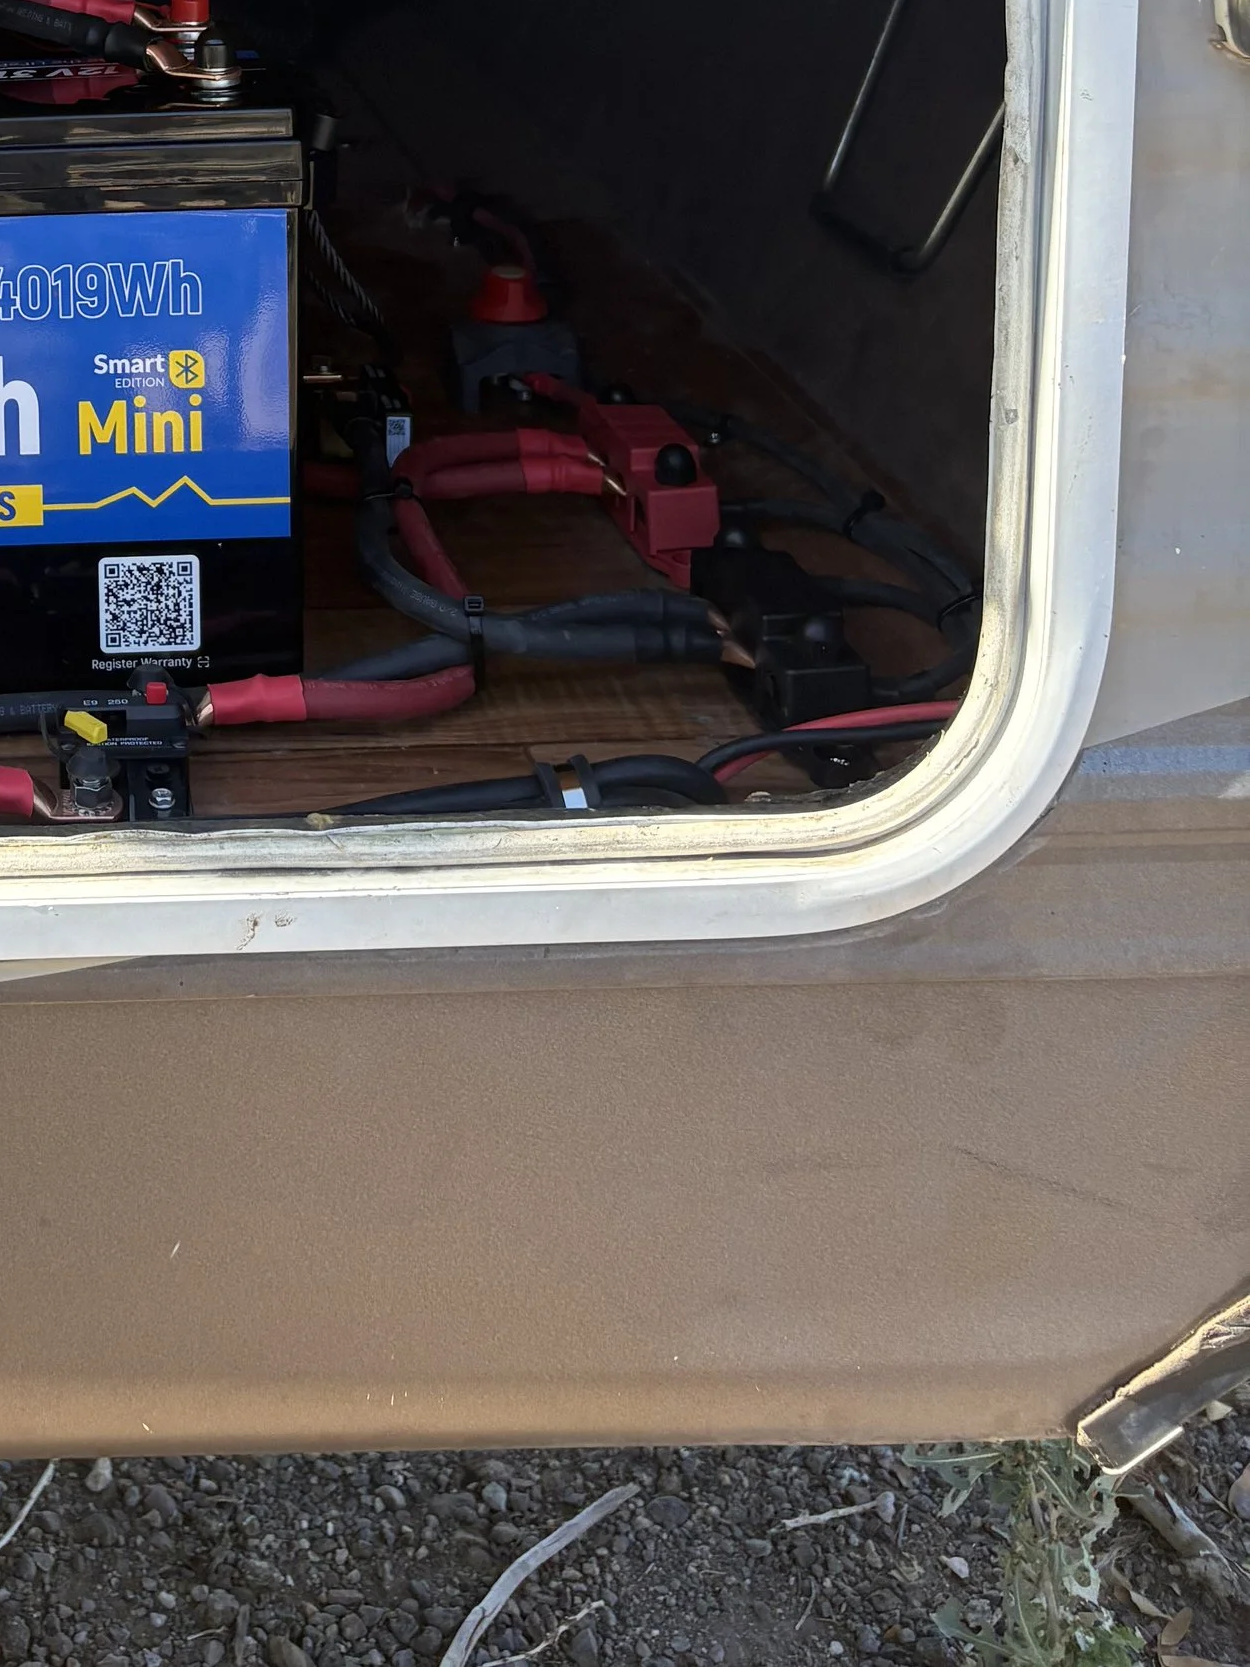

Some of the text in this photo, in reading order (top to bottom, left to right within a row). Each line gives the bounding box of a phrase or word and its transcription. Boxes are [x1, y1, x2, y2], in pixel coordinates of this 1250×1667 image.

[48, 65, 119, 78] 12V
[93, 353, 166, 375] Smart
[115, 377, 165, 389] EDITION
[78, 393, 203, 455] Mini
[92, 657, 192, 672] Register Warranty
